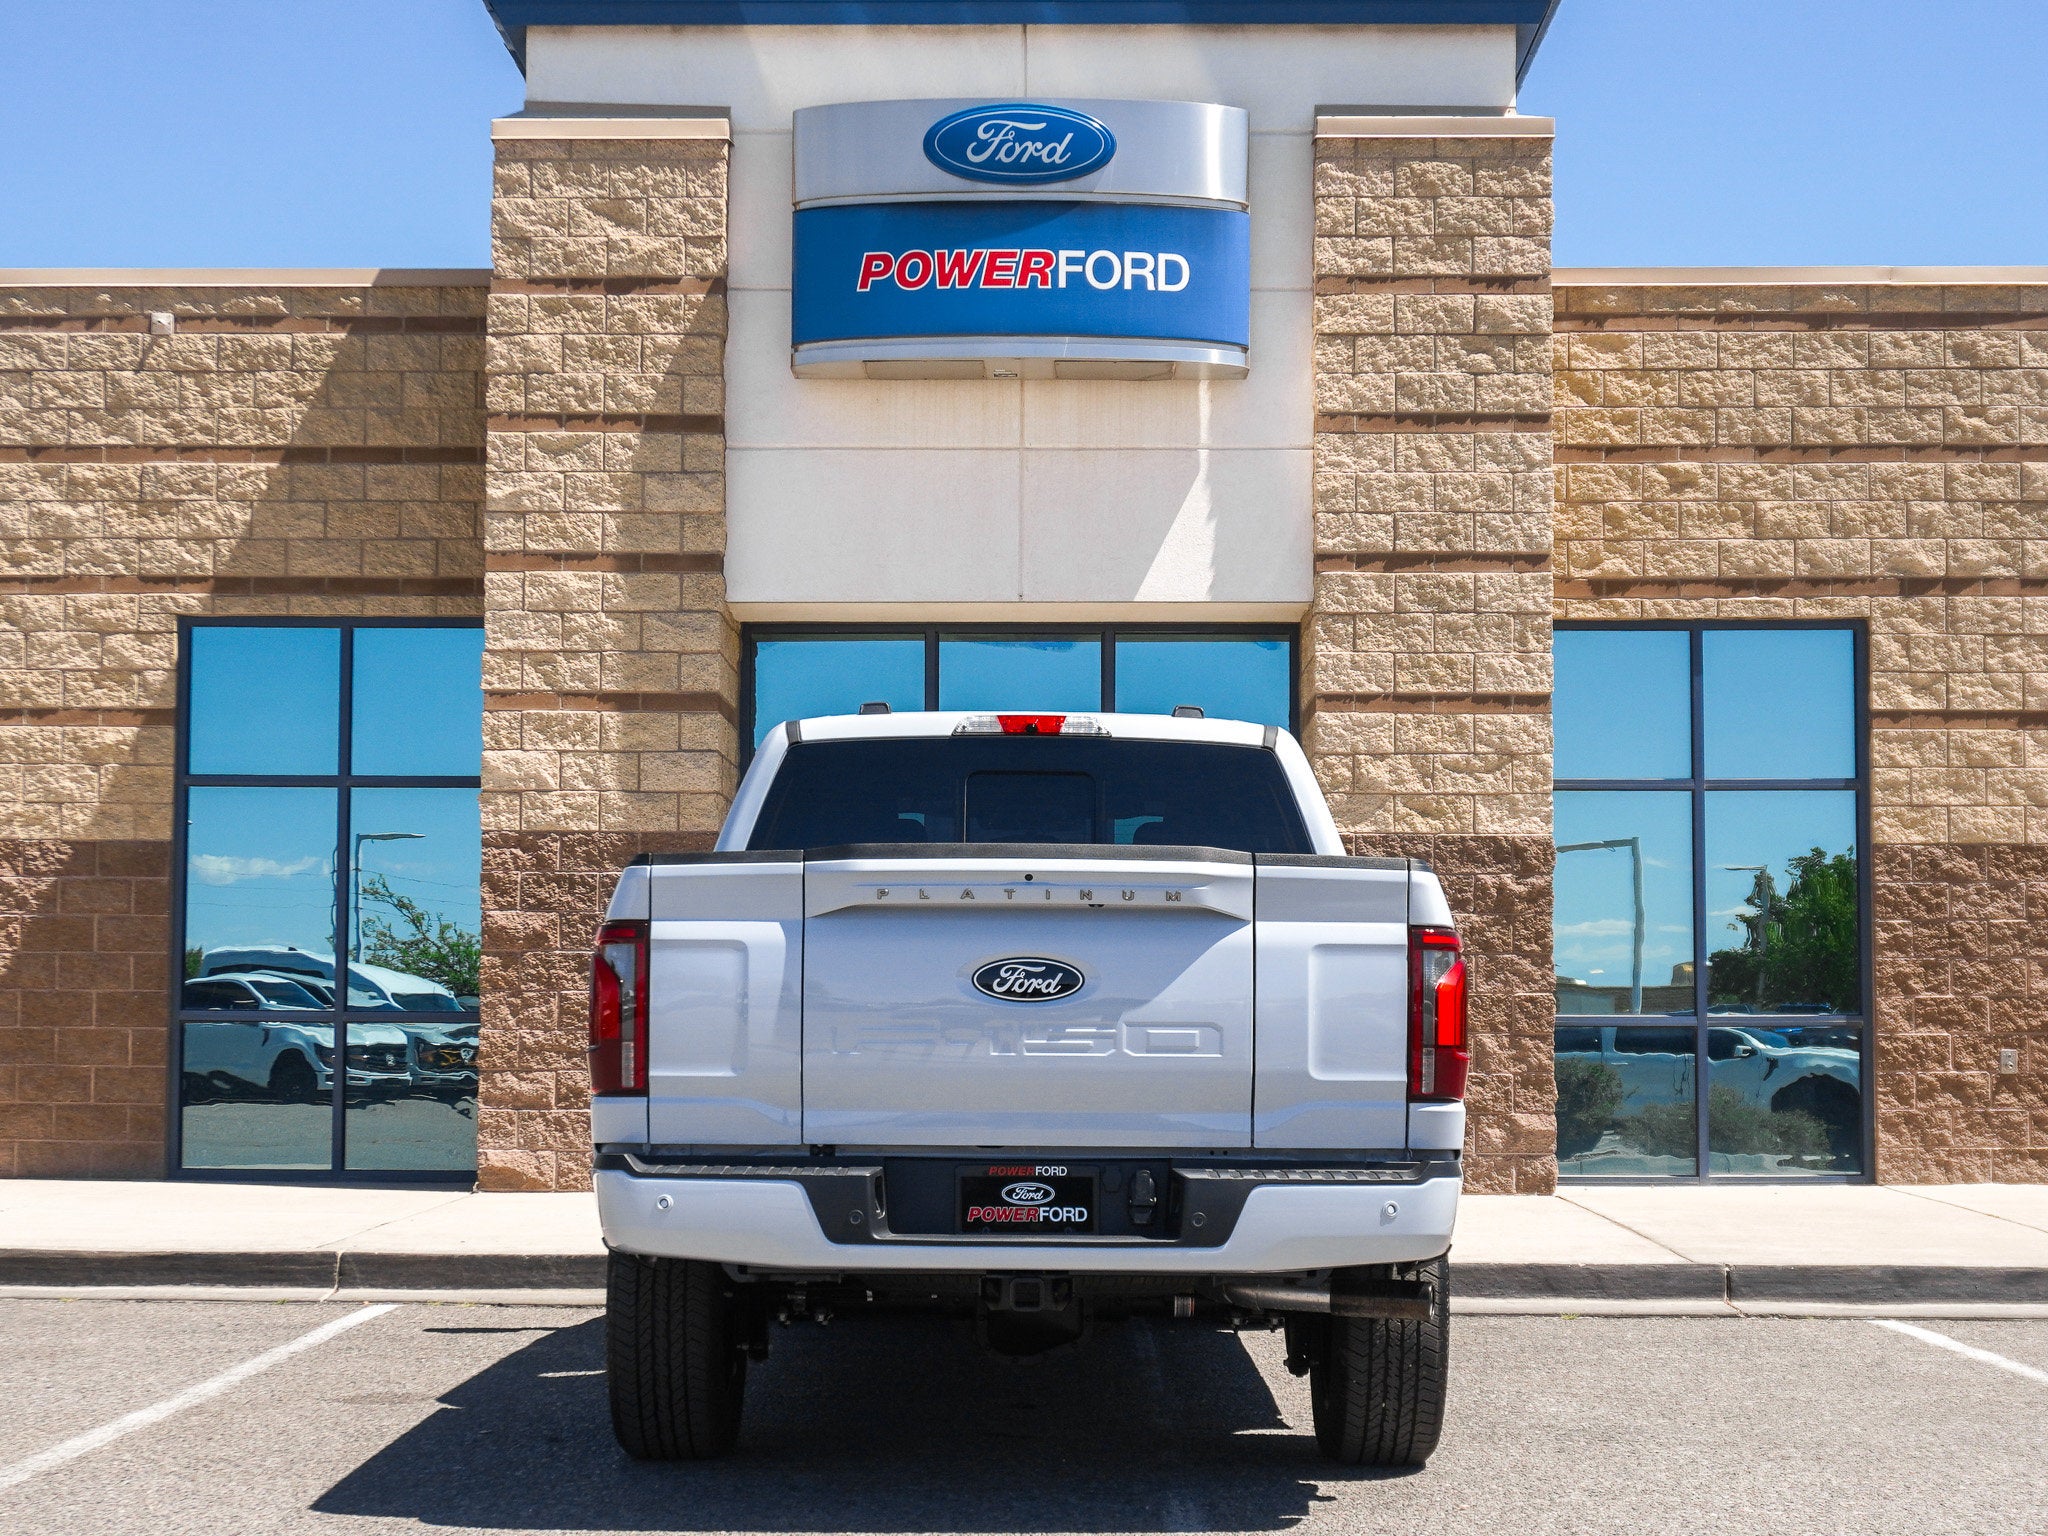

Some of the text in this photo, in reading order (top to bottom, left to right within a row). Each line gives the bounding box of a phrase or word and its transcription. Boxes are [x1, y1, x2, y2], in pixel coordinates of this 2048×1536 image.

[966, 119, 1073, 165] Ford
[877, 889, 1181, 902] PLATINUM
[993, 966, 1061, 994] Ford
[1013, 1187, 1044, 1200] Ford
